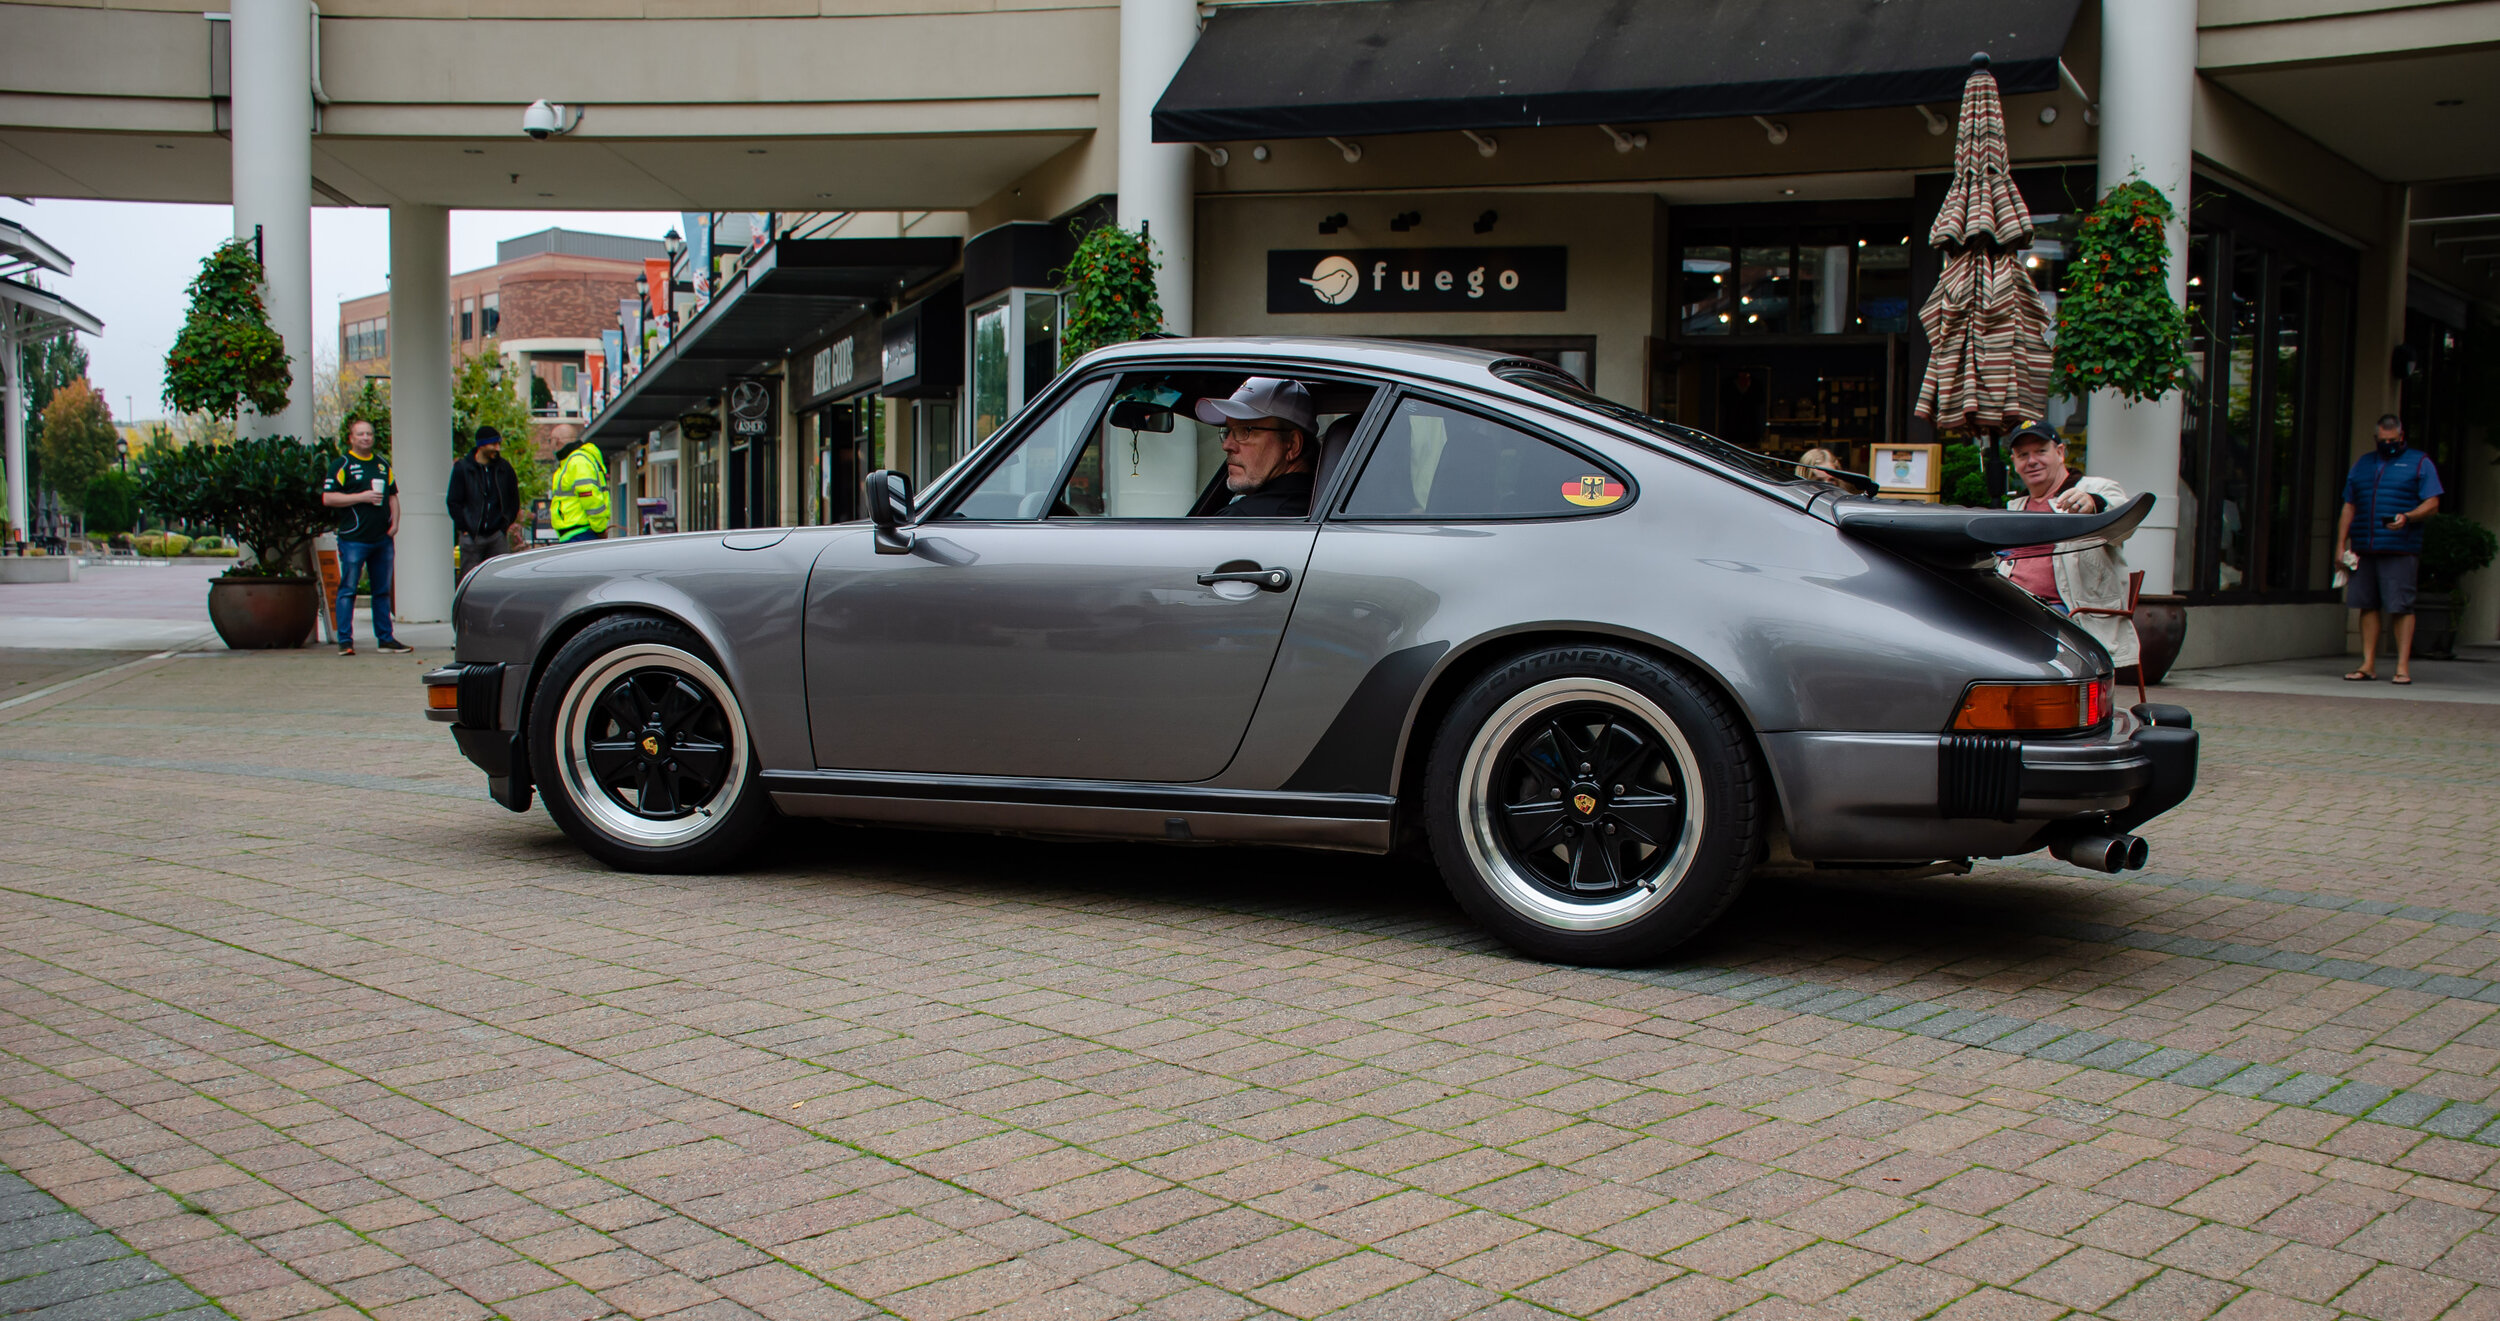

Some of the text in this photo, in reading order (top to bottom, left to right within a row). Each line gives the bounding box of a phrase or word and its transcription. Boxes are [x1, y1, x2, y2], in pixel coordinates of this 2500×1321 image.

[1372, 261, 1519, 298] fuego
[813, 347, 831, 396] ASHER
[832, 335, 853, 386] GOODS
[738, 419, 763, 432] ASHER
